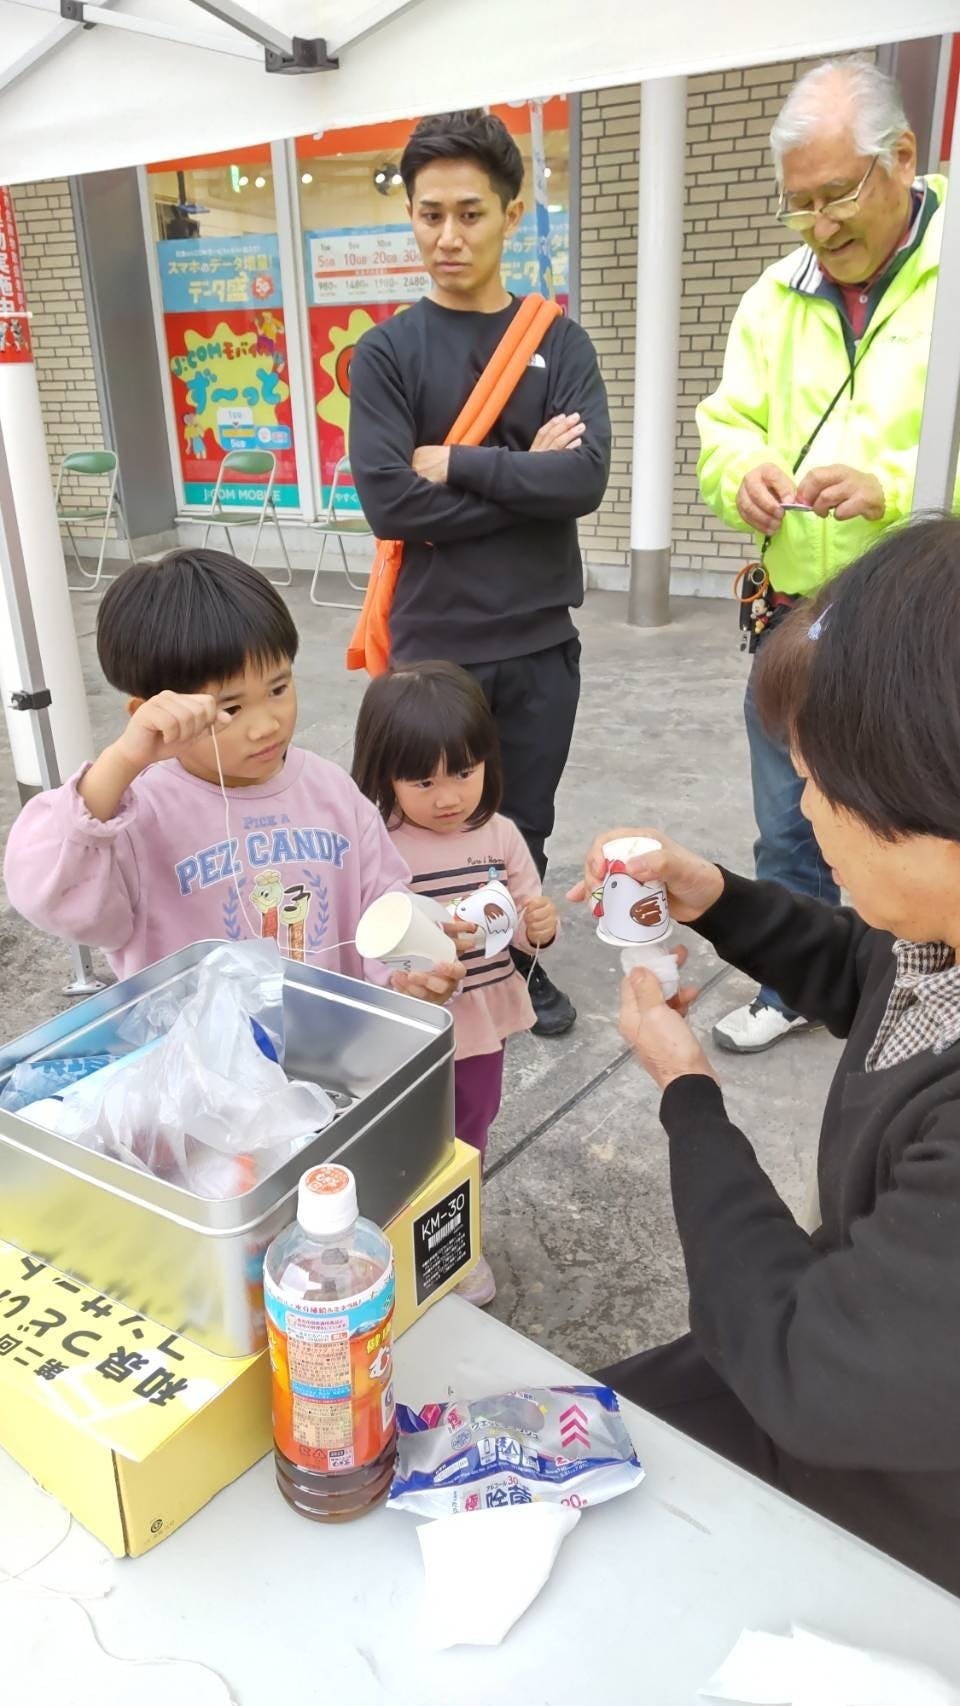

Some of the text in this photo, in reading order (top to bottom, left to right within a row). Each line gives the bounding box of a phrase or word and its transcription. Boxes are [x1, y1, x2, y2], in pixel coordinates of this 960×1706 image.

[344, 253, 367, 265] 10GB
[373, 251, 397, 264] 20GB
[238, 489, 281, 502] MOBE
[241, 813, 291, 829] PICK A
[175, 828, 351, 896] PEZ CANDY
[421, 1193, 466, 1241] KM-30
[20, 1256, 185, 1361] コンサート
